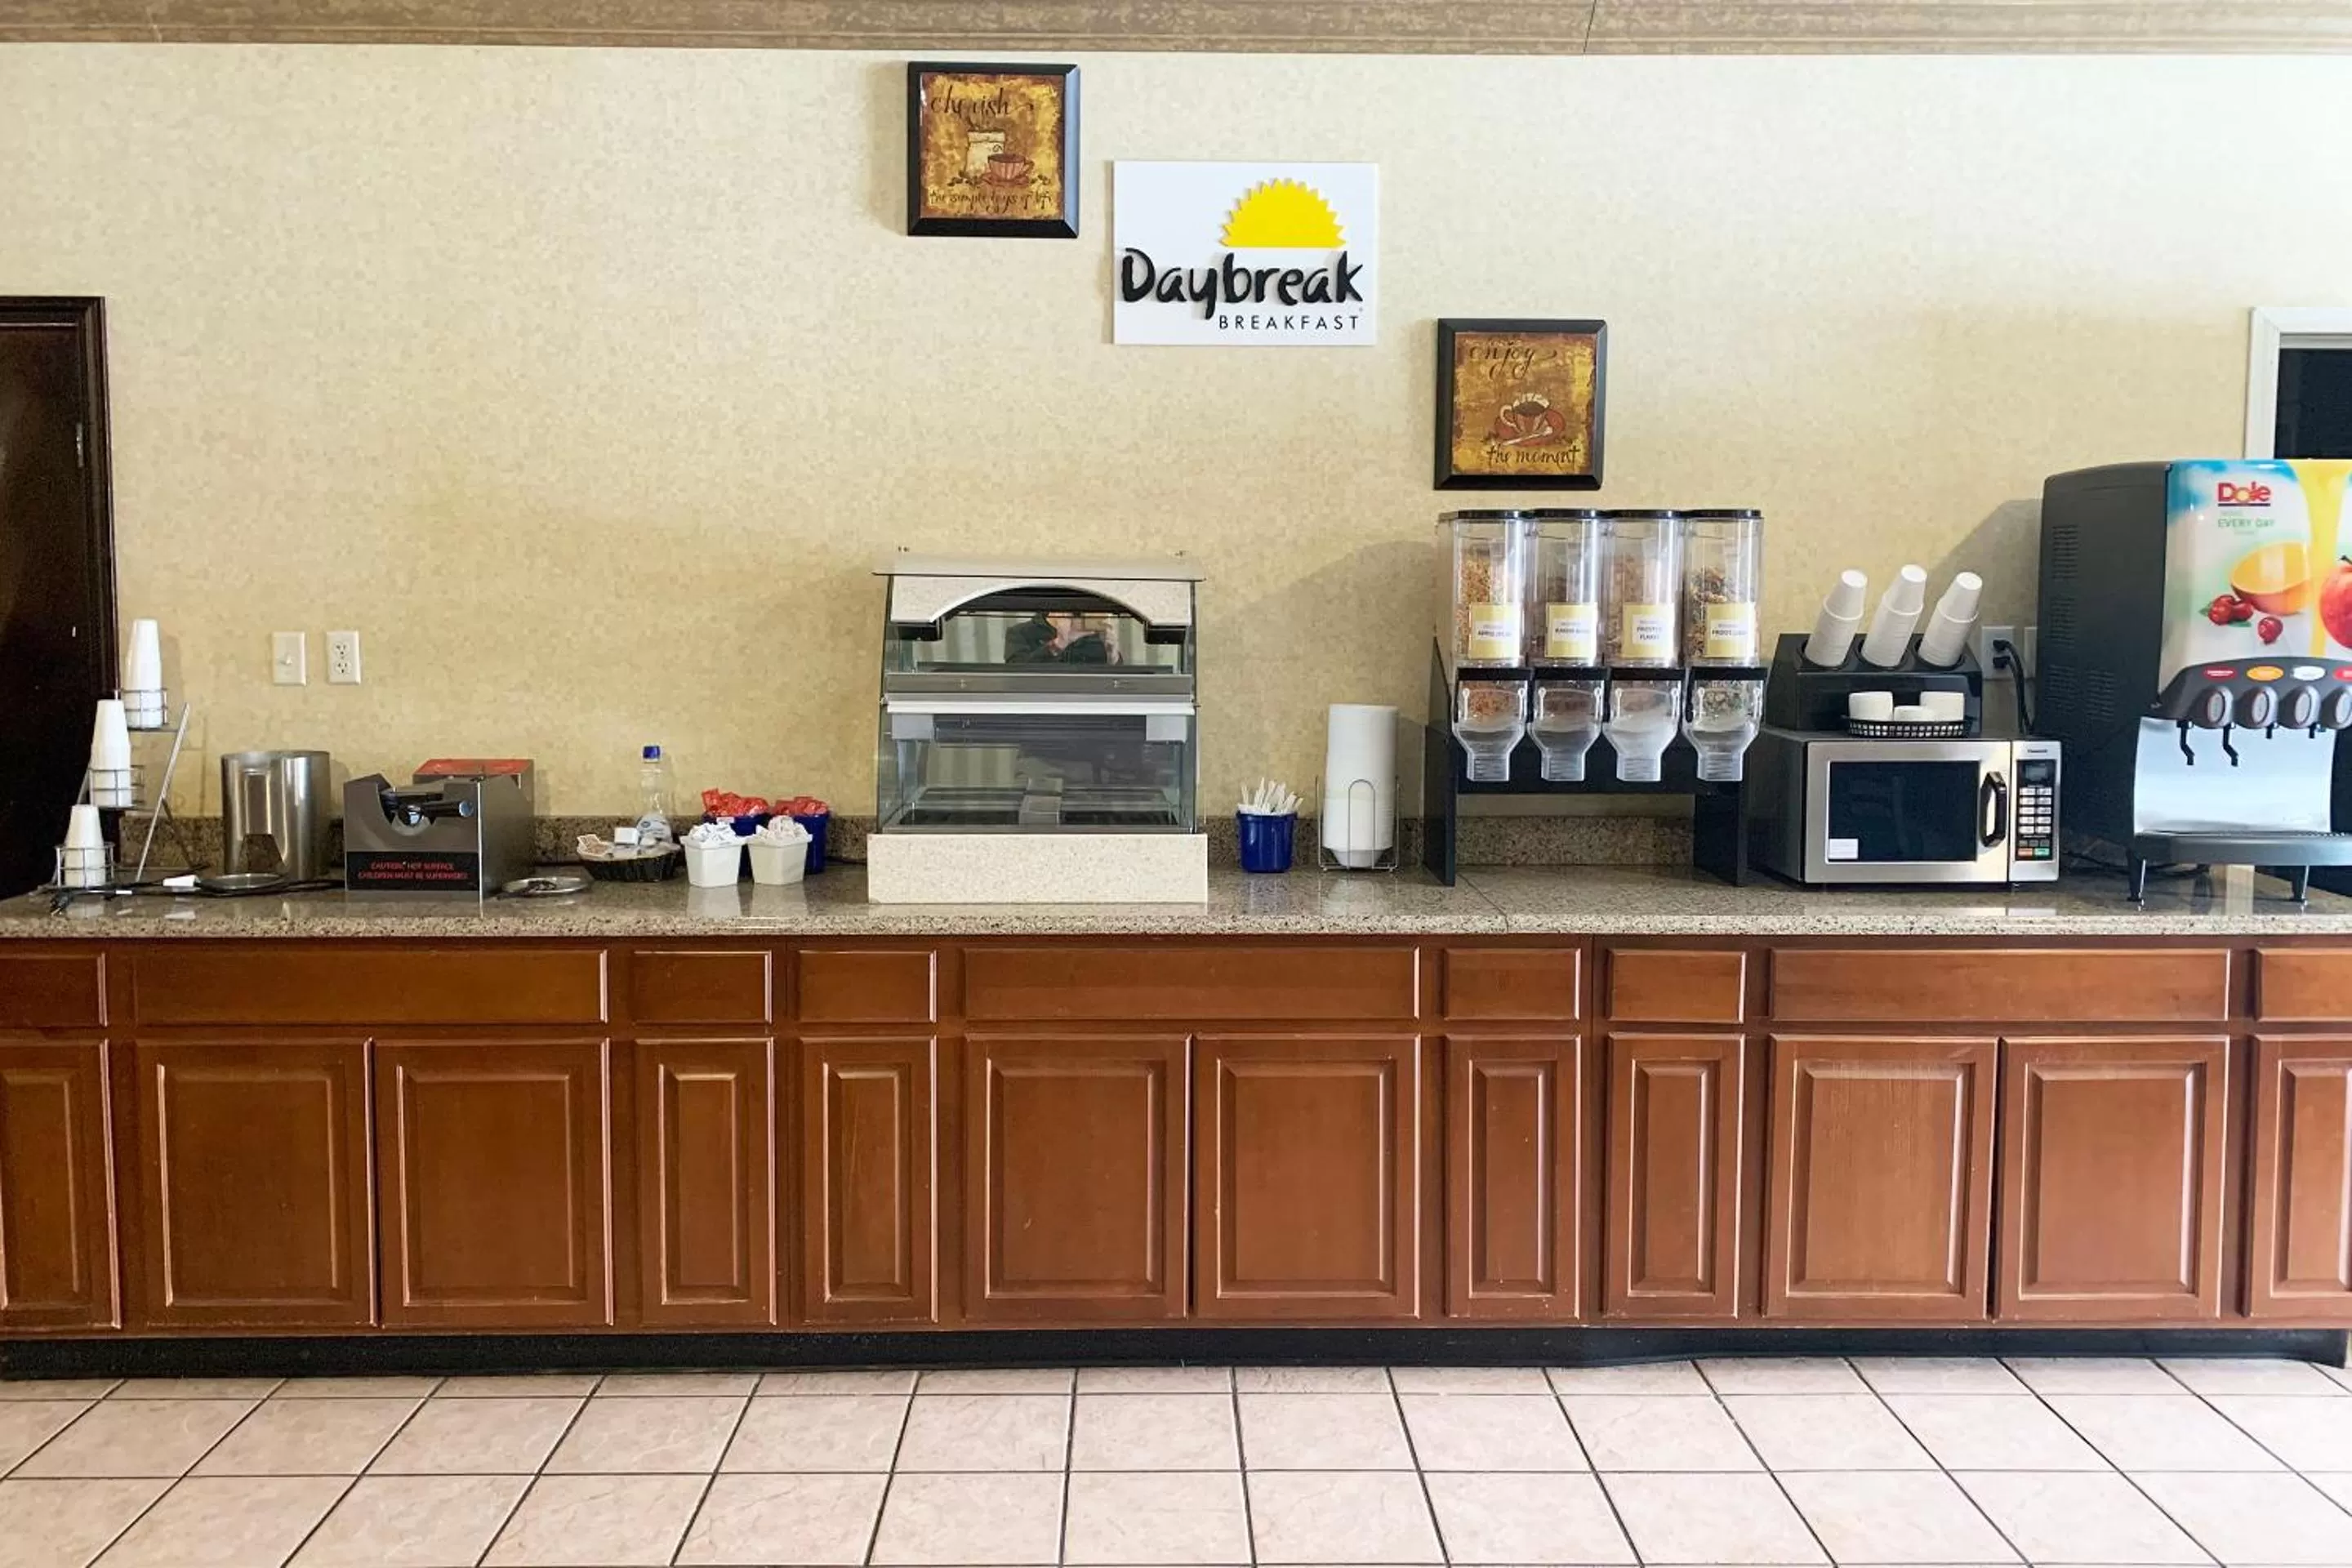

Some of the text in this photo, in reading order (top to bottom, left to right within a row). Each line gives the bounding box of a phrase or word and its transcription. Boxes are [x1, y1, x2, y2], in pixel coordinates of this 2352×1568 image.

[930, 84, 1021, 116] cherish
[1121, 247, 1363, 319] Daybreak
[1219, 315, 1359, 330] BREAKFAST
[1469, 341, 1539, 380] enjoy
[1486, 445, 1580, 468] the moment
[2217, 480, 2271, 503] Dole
